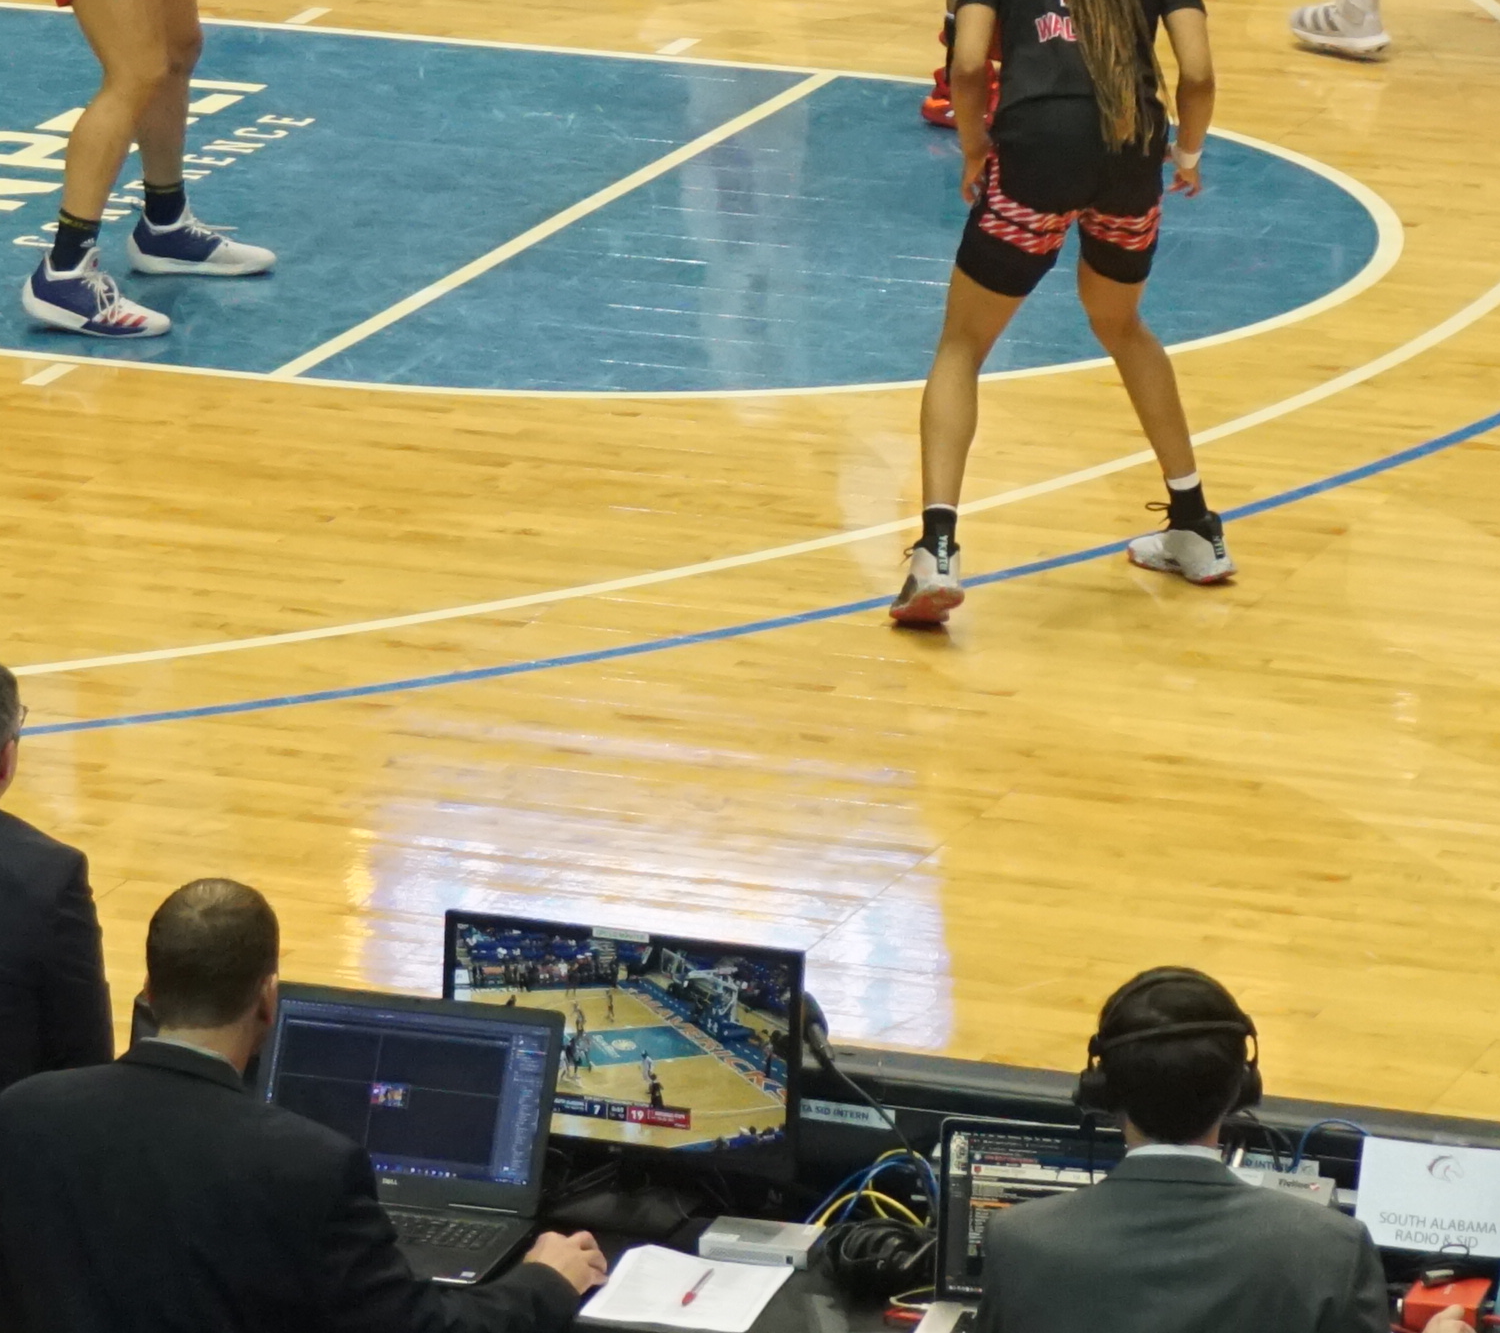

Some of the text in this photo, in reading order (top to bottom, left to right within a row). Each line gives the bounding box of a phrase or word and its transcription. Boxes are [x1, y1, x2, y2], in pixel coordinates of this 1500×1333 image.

[630, 1109, 645, 1121] 19
[833, 1108, 870, 1122] INTERN
[1379, 1211, 1498, 1234] SOUTH ALABAMA
[1394, 1229, 1479, 1249] RADIO & SID
